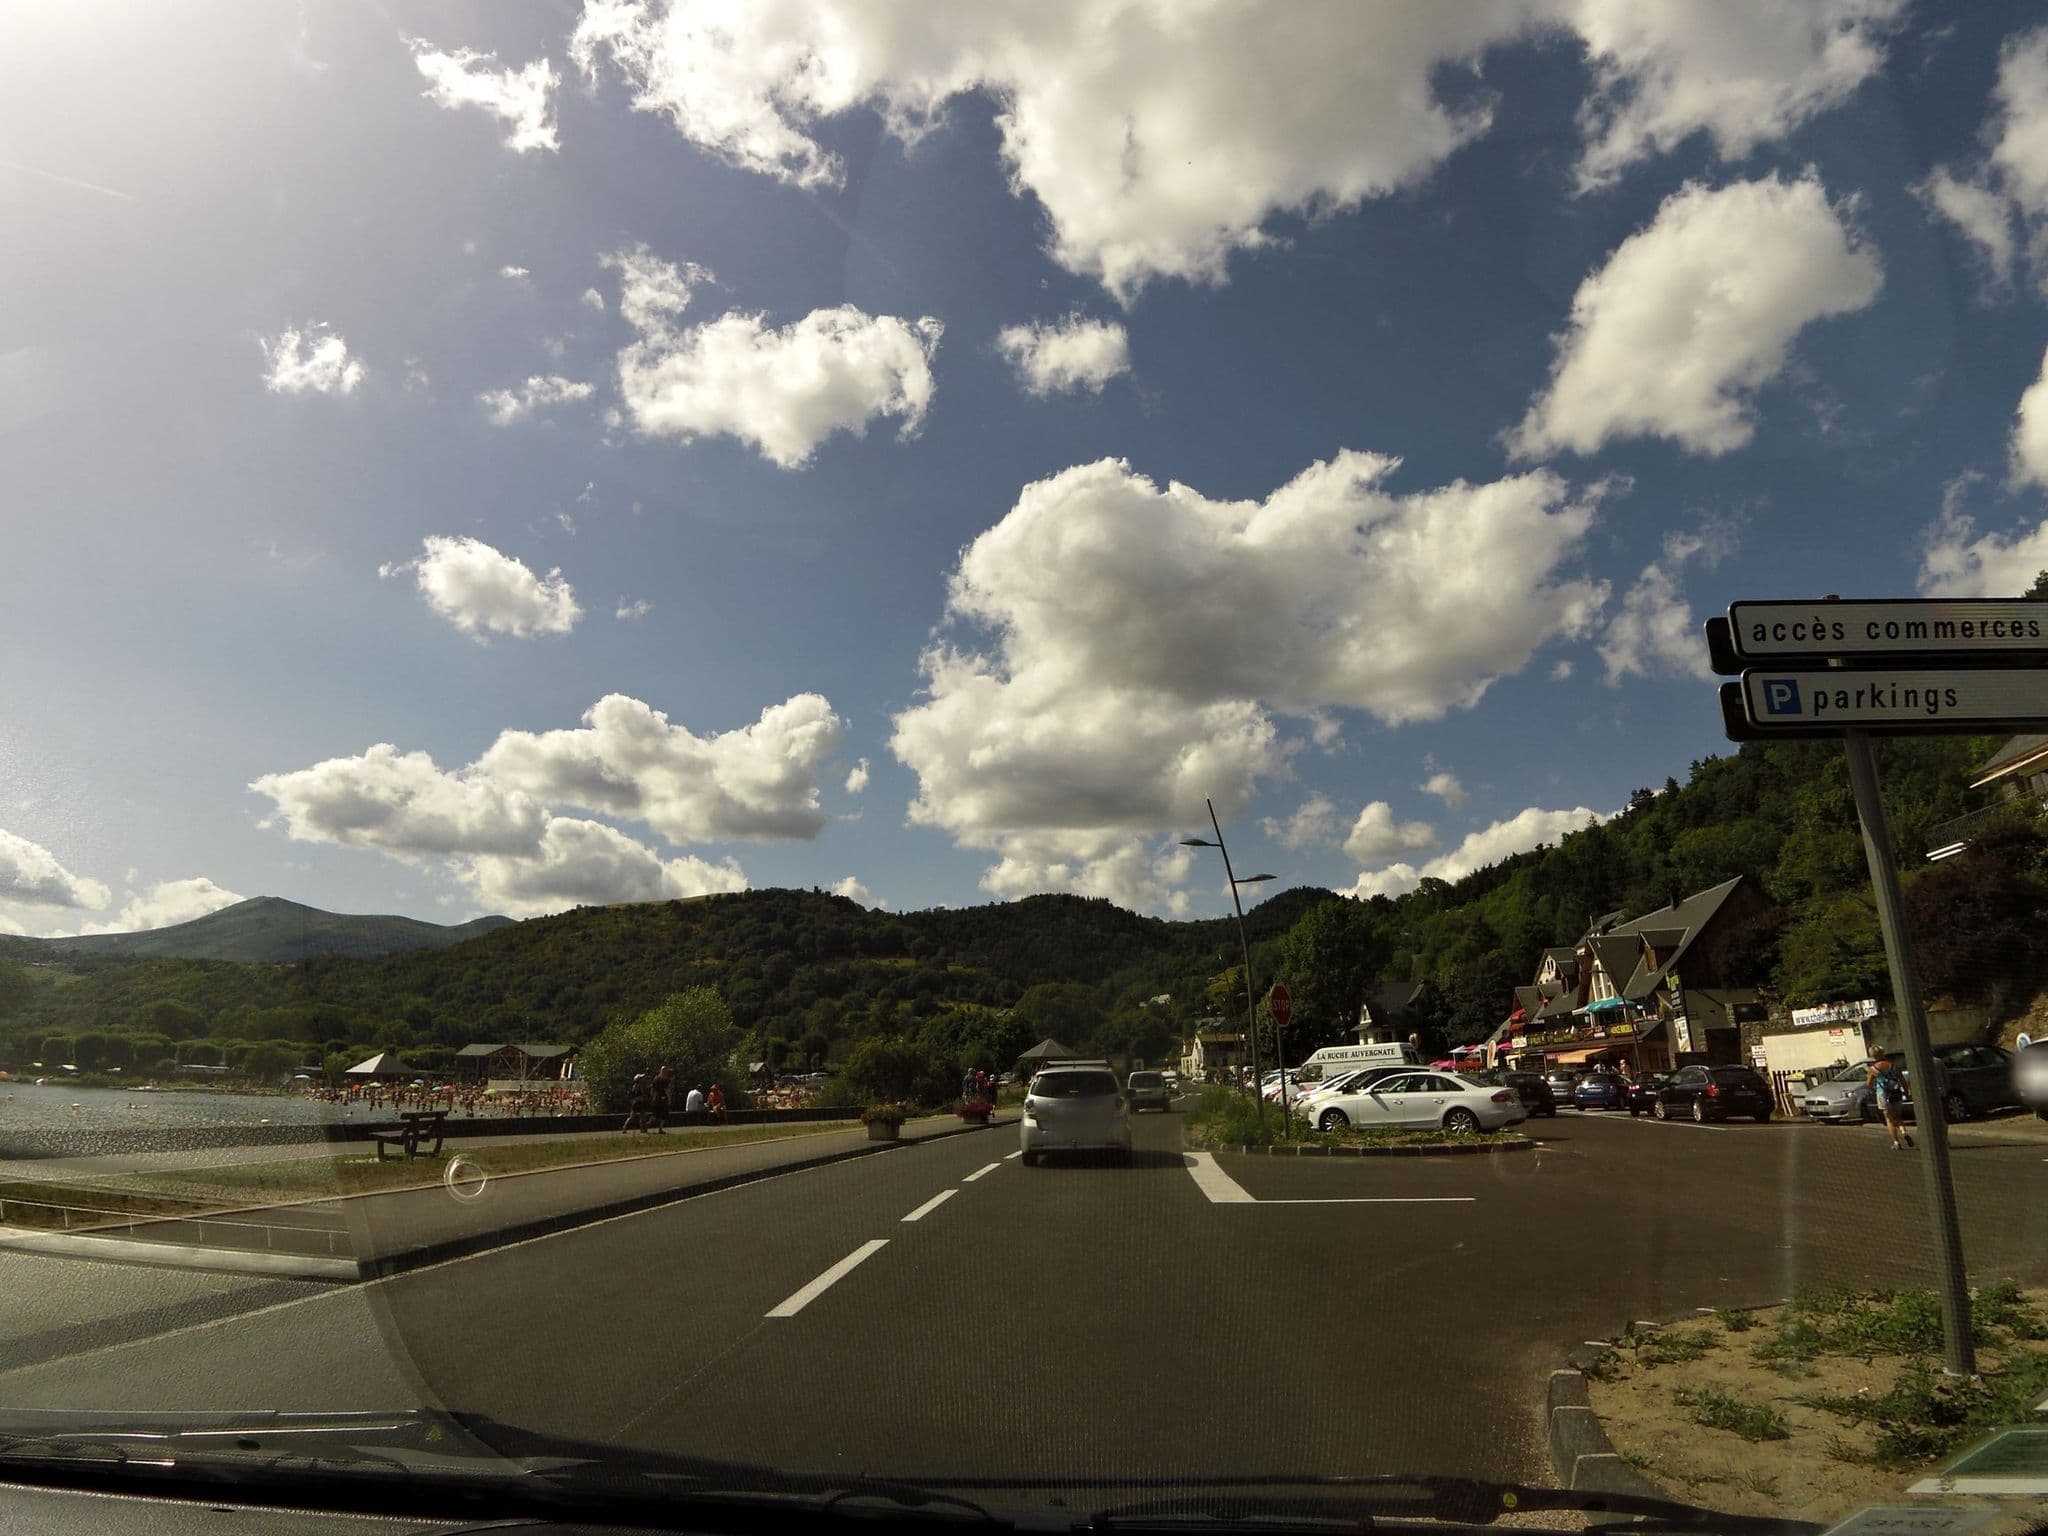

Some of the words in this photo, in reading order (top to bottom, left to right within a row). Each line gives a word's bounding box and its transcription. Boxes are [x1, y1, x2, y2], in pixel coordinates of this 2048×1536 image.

[1752, 616, 1845, 642] accès
[1866, 619, 2041, 641] commerces
[1770, 683, 1792, 711] P
[1813, 682, 1959, 716] parkings
[1273, 1000, 1290, 1010] STOP
[1327, 1051, 1348, 1060] RUCHE
[1350, 1048, 1396, 1058] AUVERGNATE
